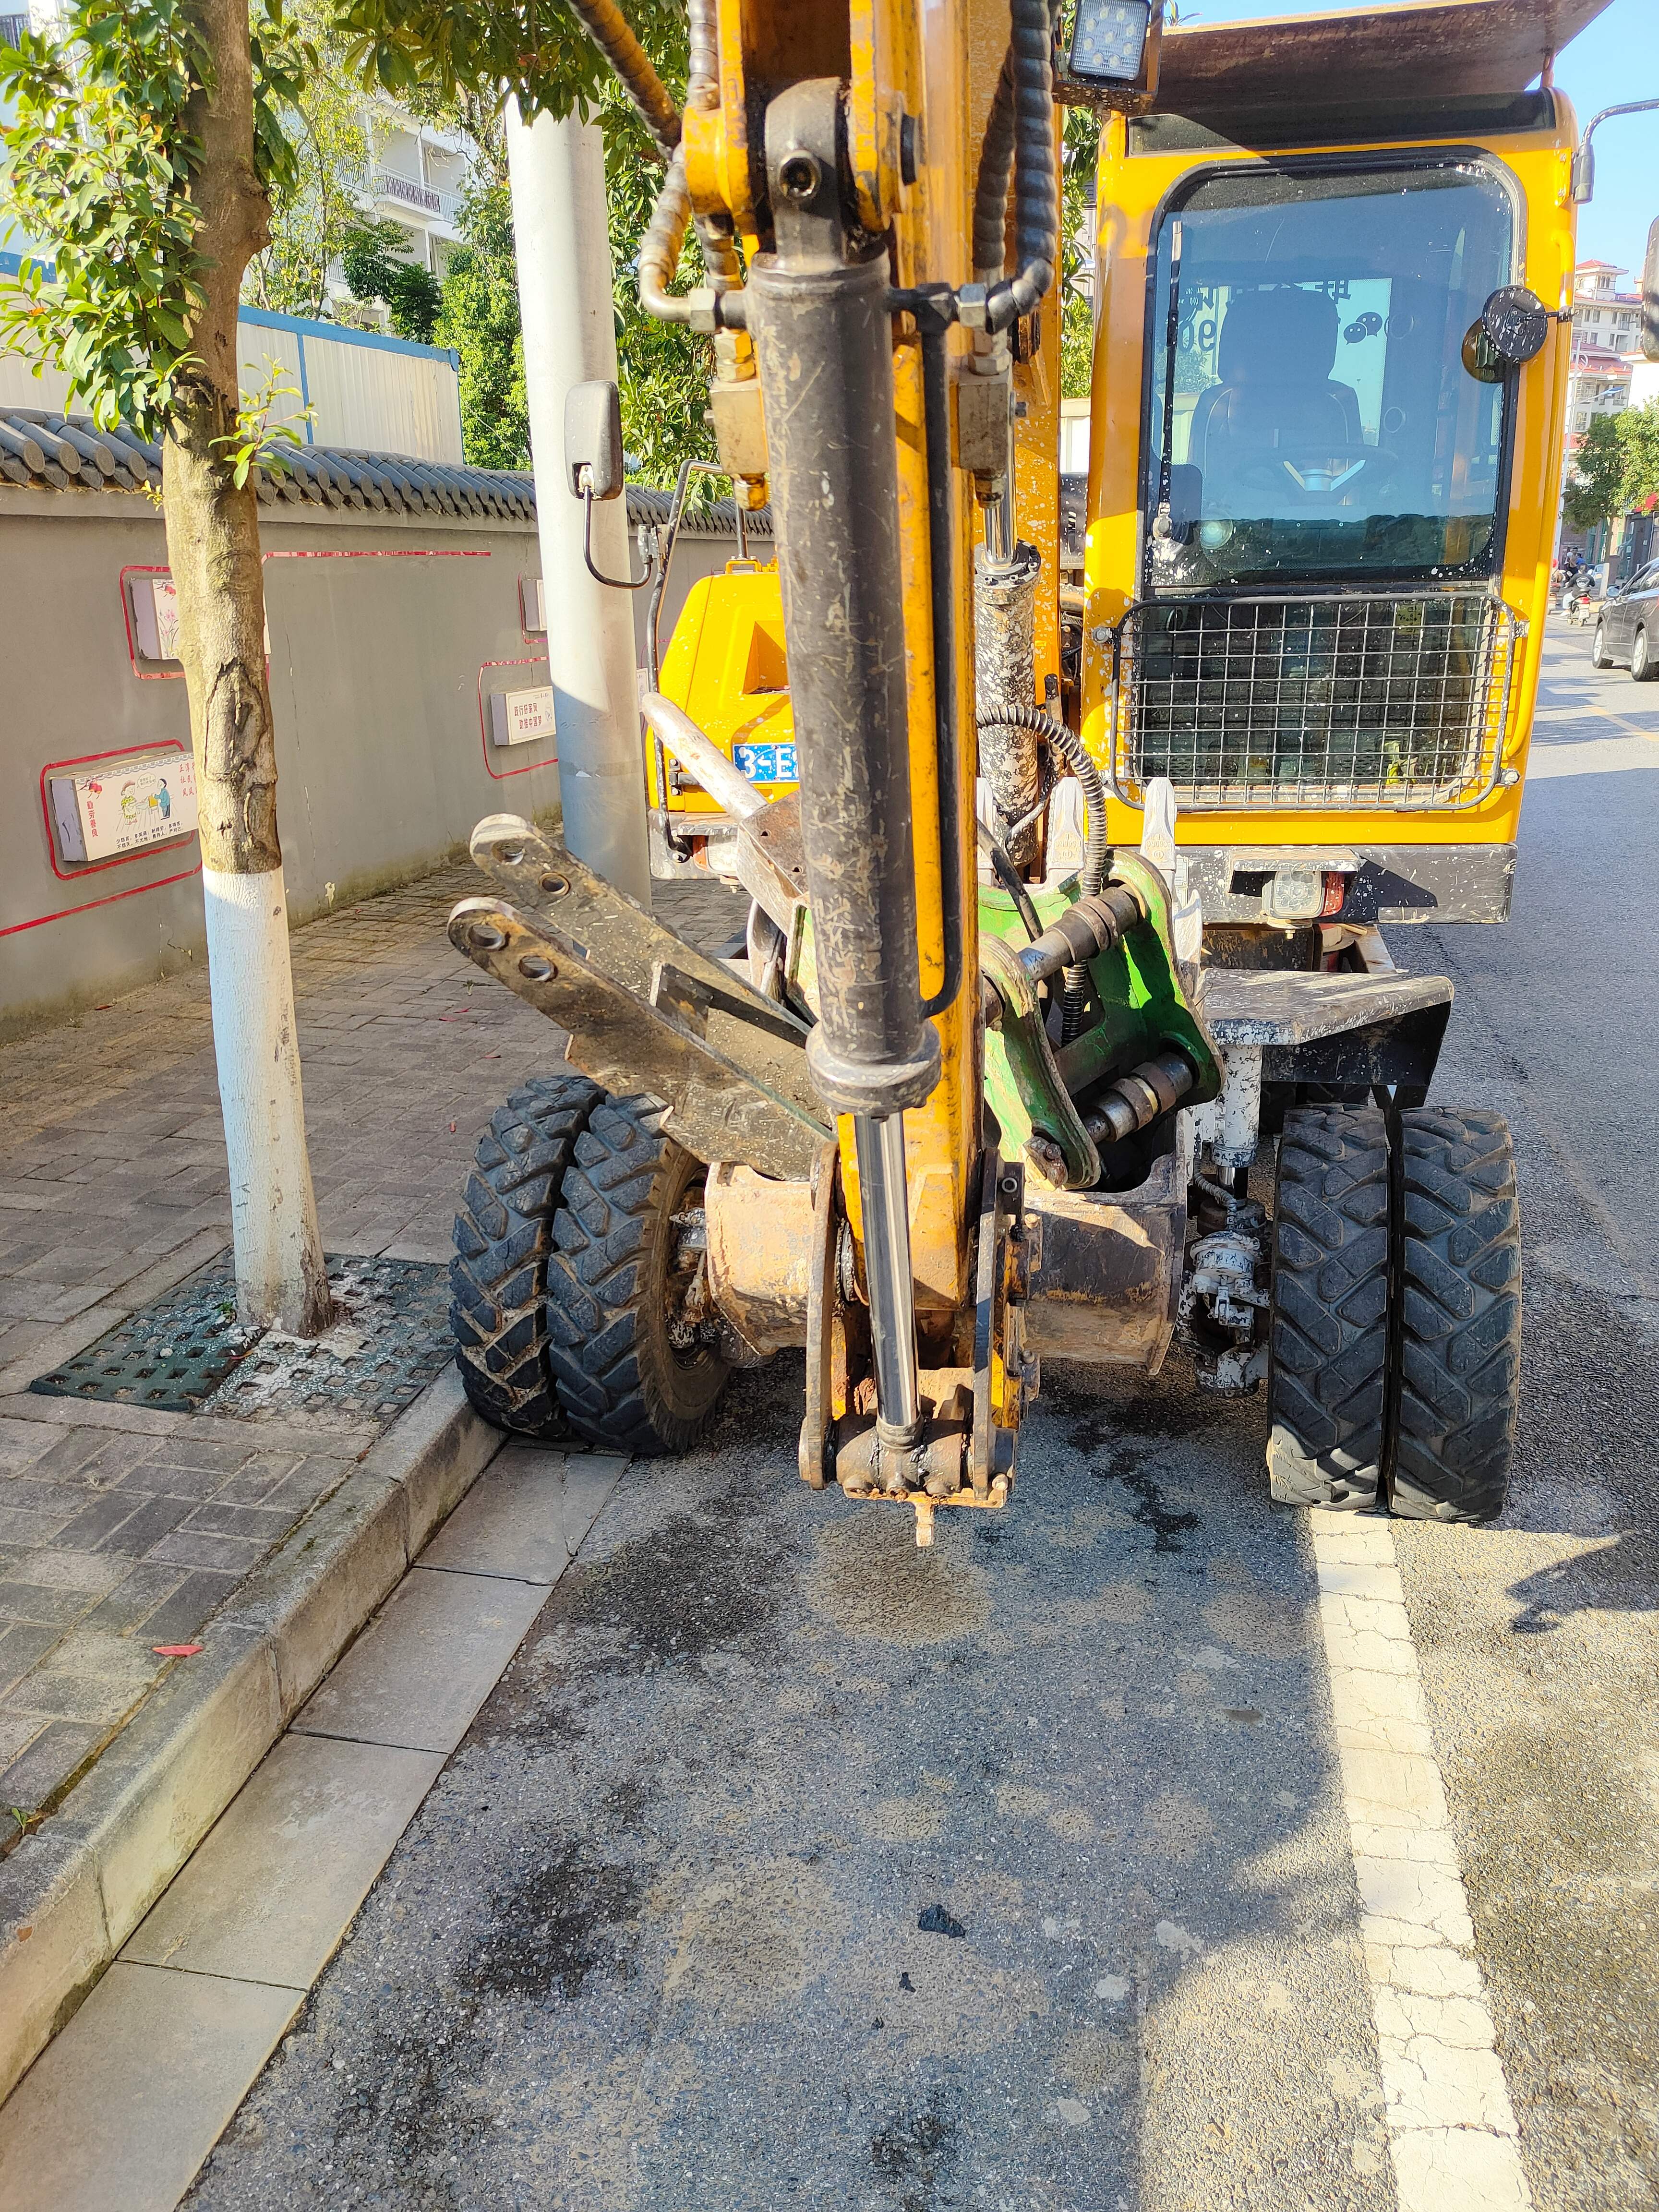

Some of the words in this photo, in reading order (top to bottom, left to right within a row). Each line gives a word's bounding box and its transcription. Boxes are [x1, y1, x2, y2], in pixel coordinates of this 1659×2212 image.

[514, 703, 537, 716] 践行好家风
[519, 716, 541, 729] 助推中国梦
[738, 746, 799, 779] 3-E
[86, 800, 98, 838] 勤劳善良
